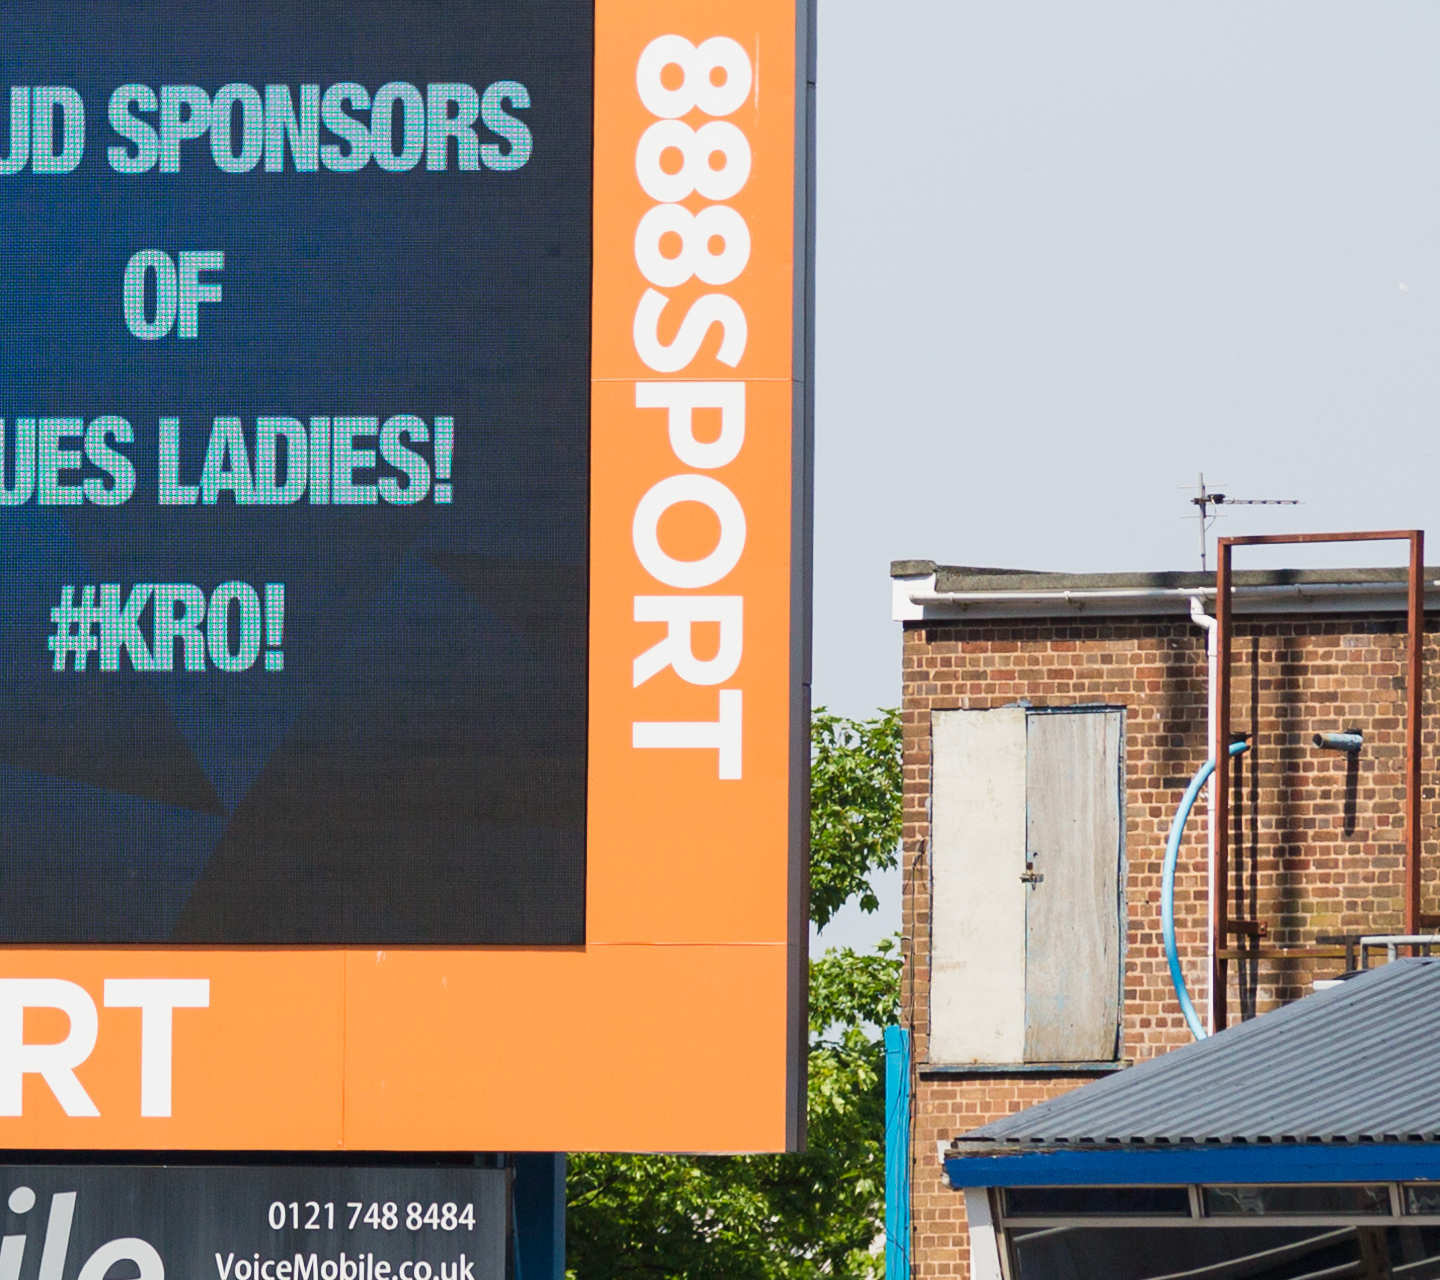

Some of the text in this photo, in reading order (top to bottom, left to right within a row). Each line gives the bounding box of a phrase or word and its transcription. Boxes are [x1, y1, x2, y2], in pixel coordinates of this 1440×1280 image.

[106, 80, 534, 175] SPONSORS
[122, 248, 226, 341] OF
[629, 33, 753, 781] 888SPORT
[157, 413, 455, 506] LADIES!
[48, 580, 287, 673] #KRO!
[267, 1200, 476, 1231] 0121 748 8484
